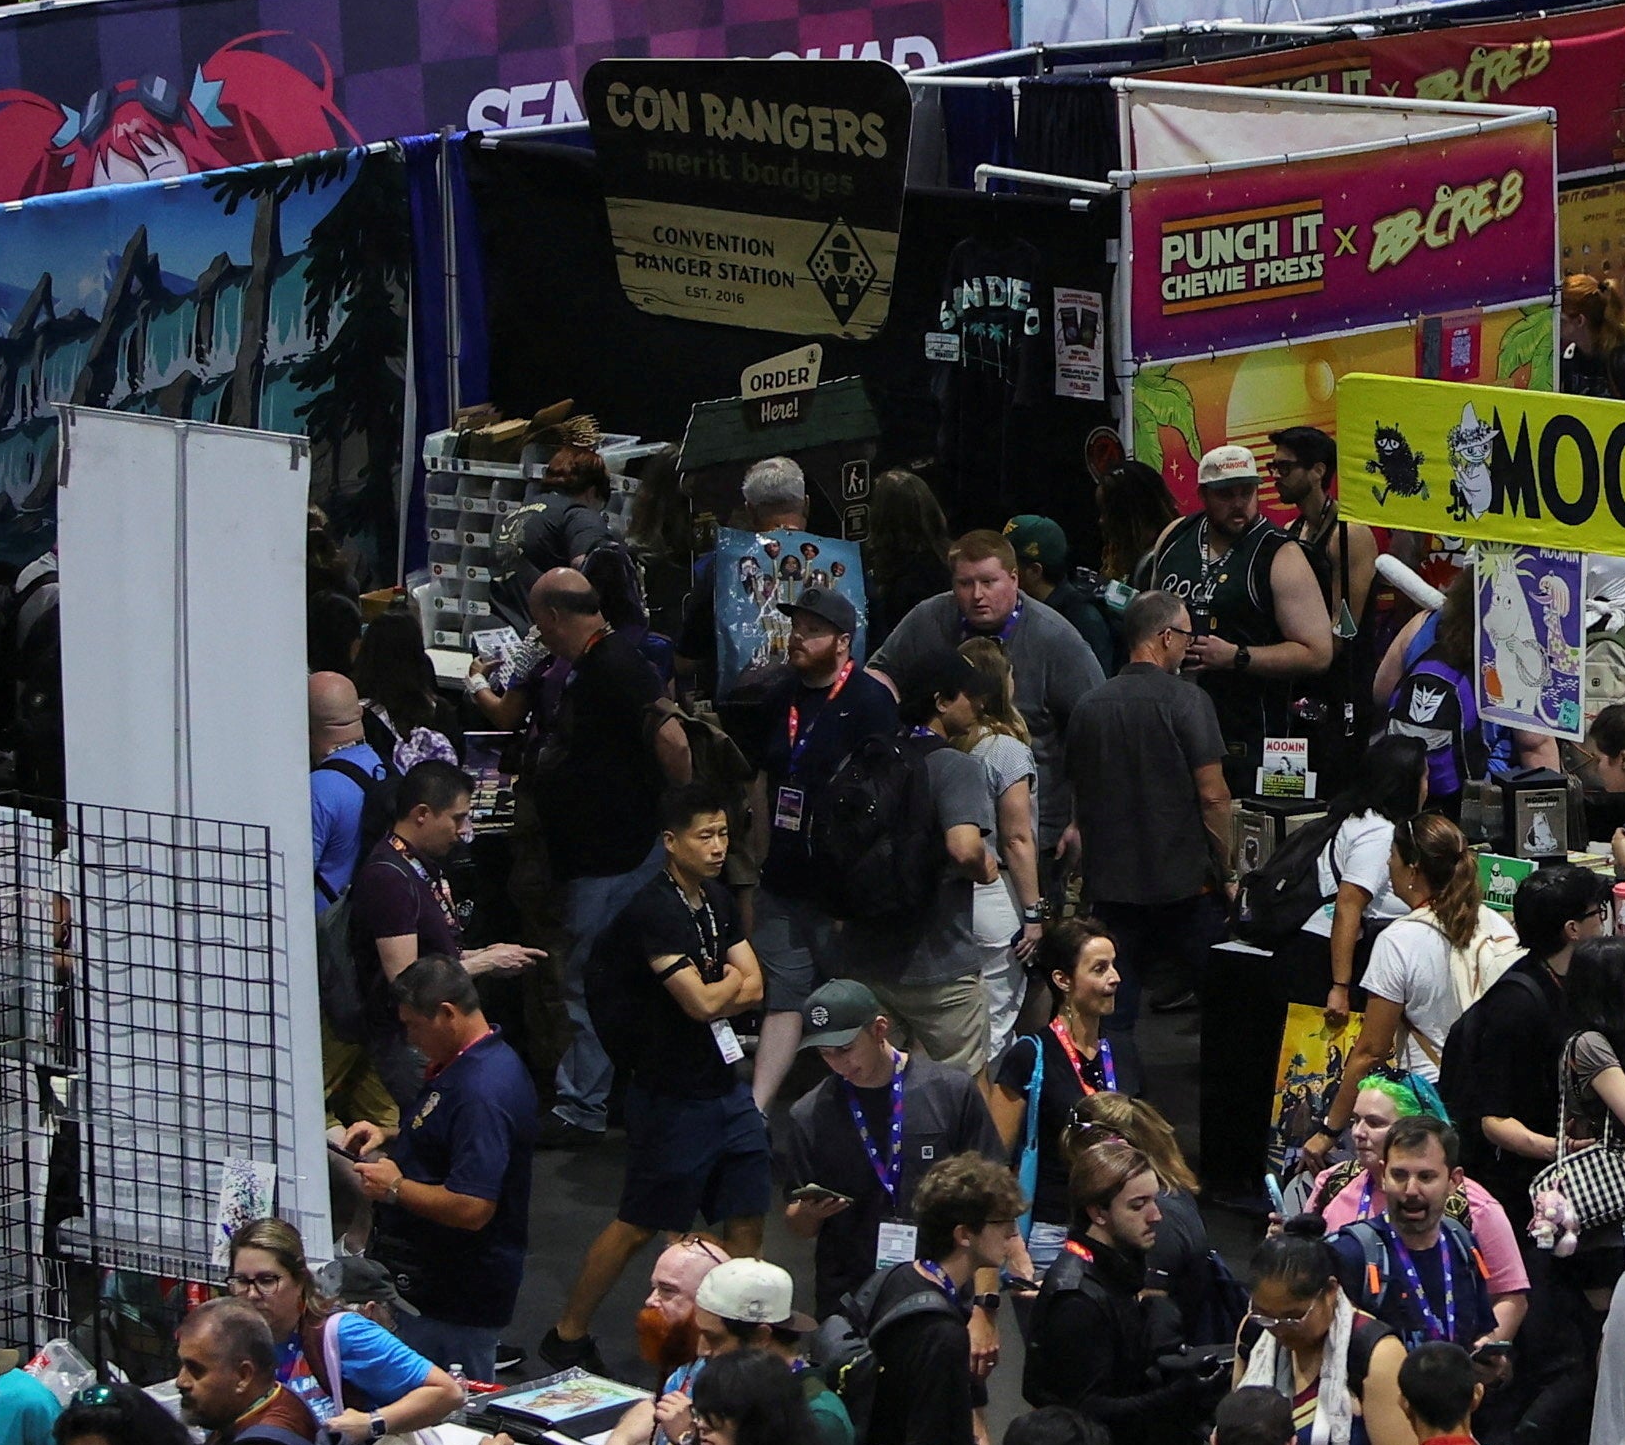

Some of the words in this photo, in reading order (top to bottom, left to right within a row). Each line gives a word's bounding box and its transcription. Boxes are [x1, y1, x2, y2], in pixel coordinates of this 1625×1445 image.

[605, 81, 690, 134] CON
[701, 91, 888, 159] RANGERS
[645, 148, 728, 180] merit
[740, 154, 853, 203] badges
[652, 224, 774, 259] CONVENTION
[634, 253, 710, 280] RANGER
[716, 261, 795, 289] STATION
[1160, 265, 1246, 301] CHEWIE
[1254, 253, 1325, 285] PRESS
[684, 286, 709, 302] EST.
[714, 290, 745, 306] 2016
[749, 367, 810, 394] ORDER
[760, 397, 799, 424] Here!
[1539, 546, 1580, 564] MOOMIN
[1265, 740, 1306, 753] MOOMIN
